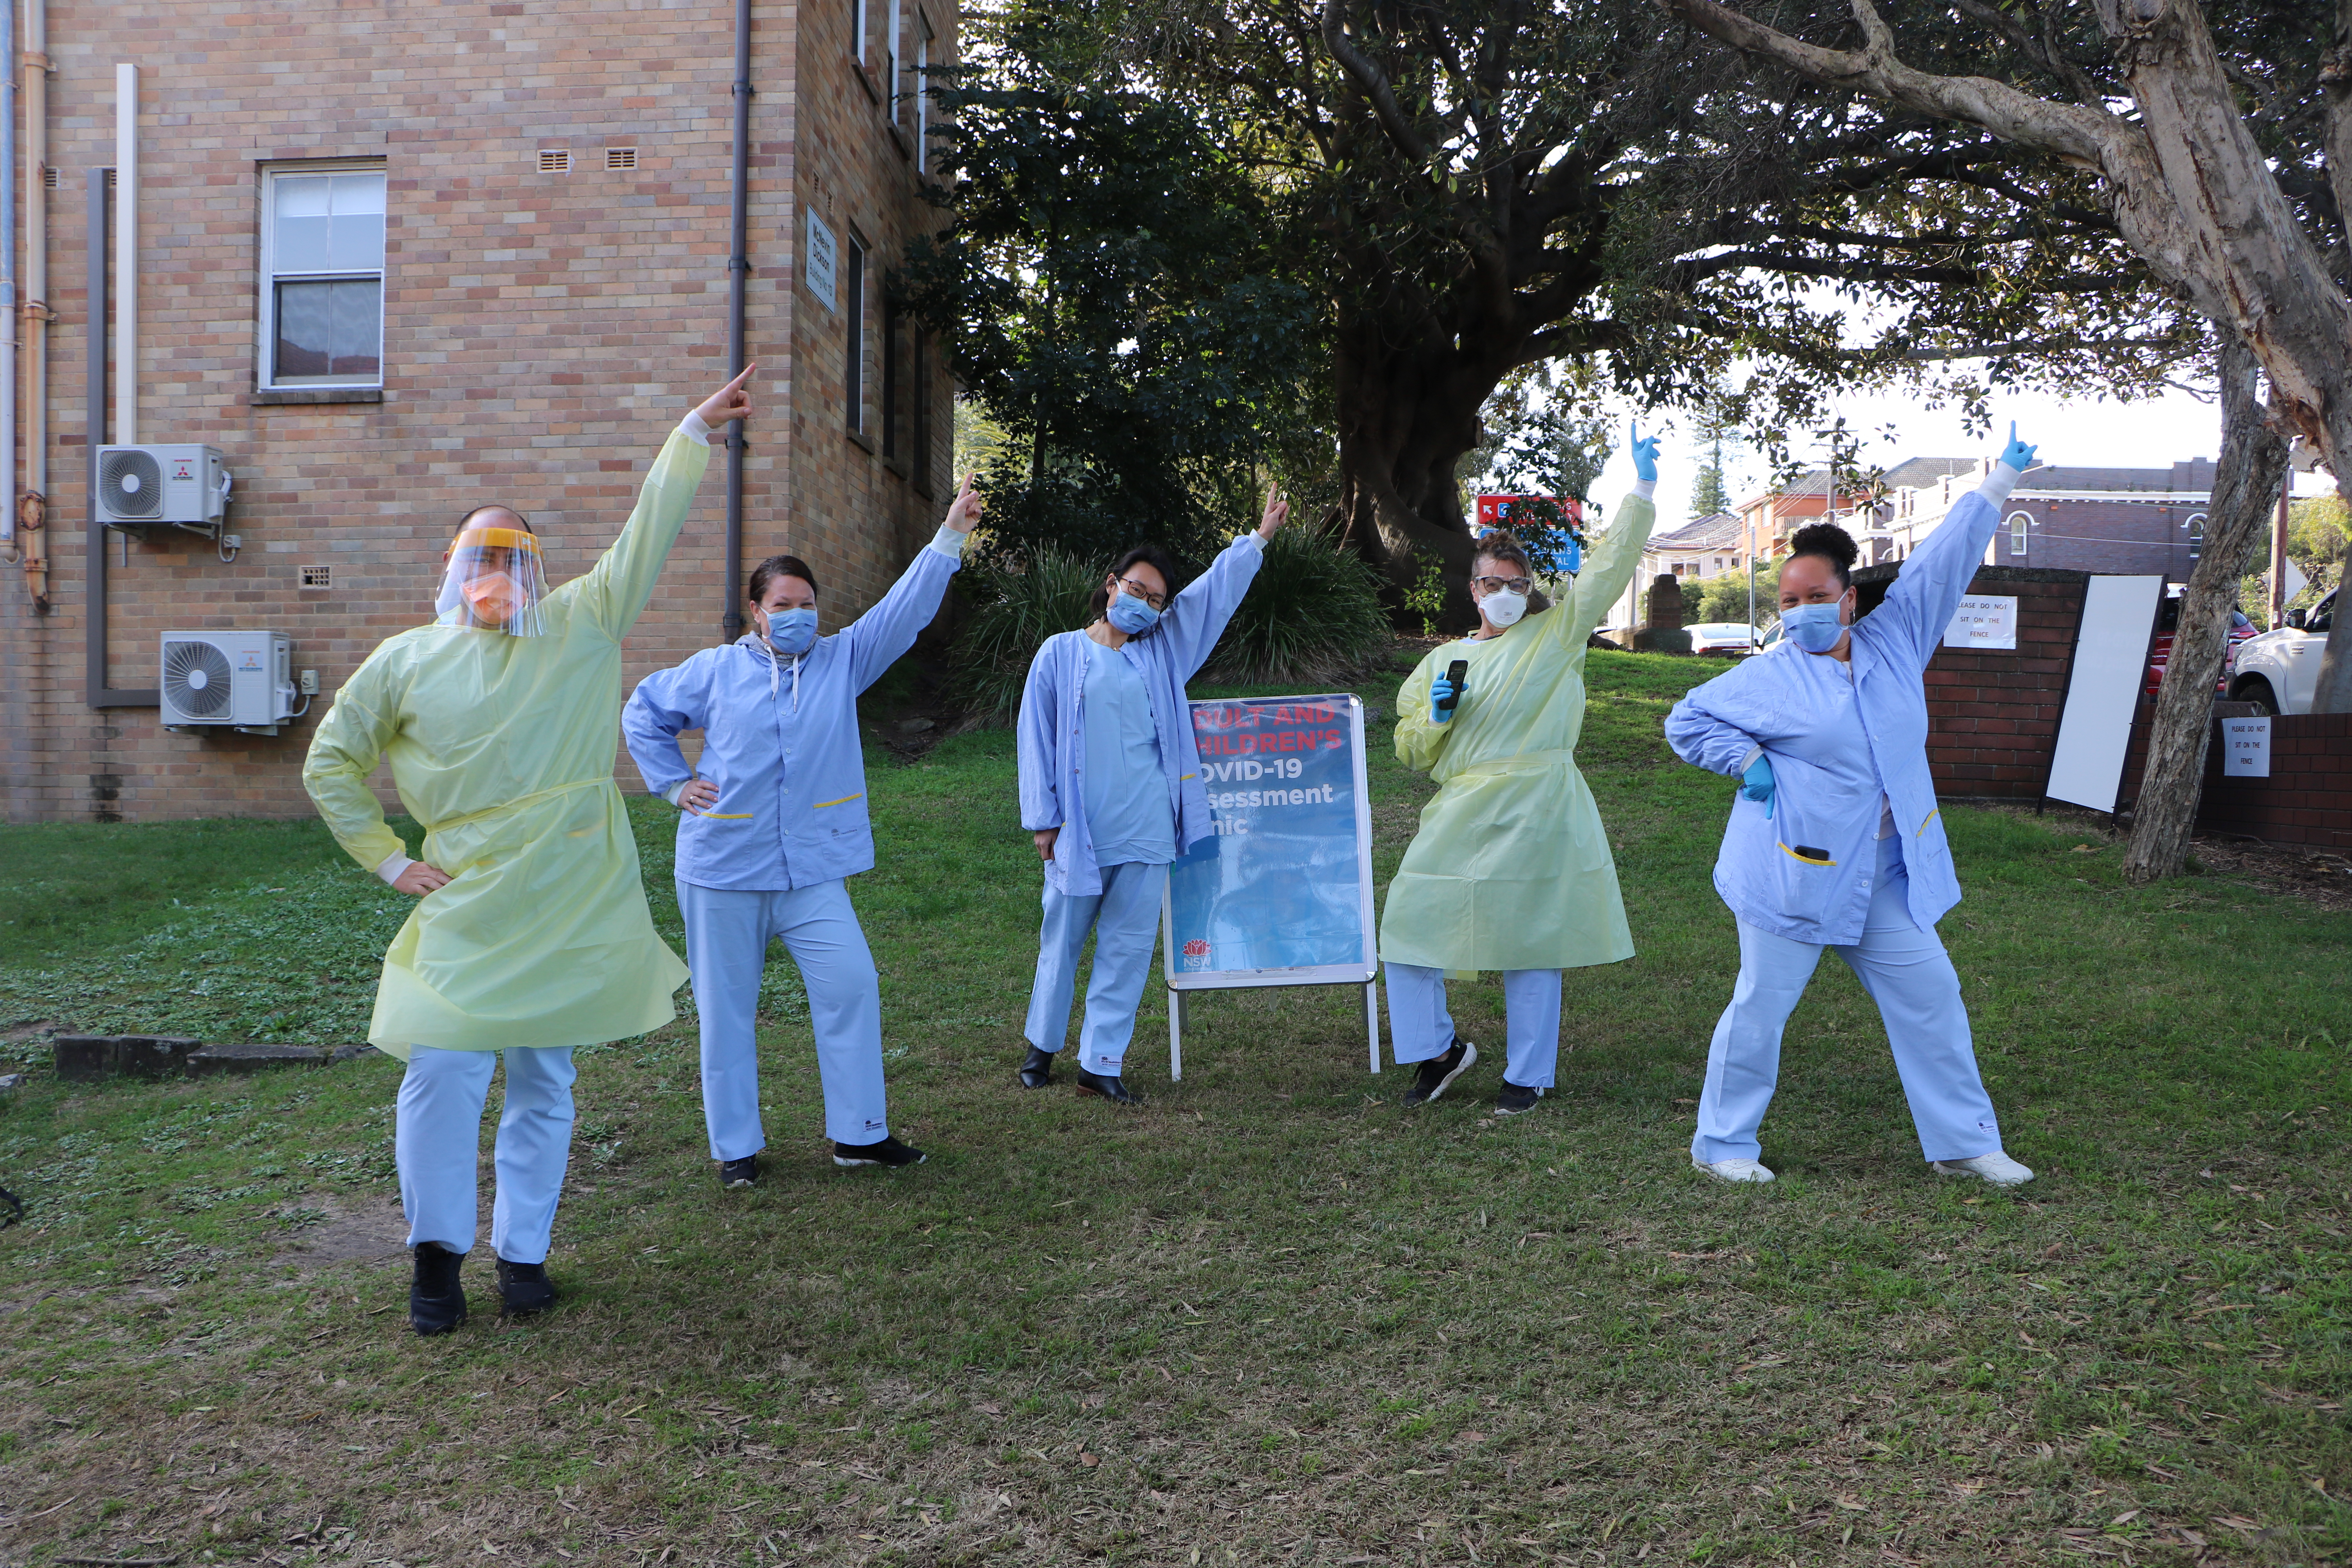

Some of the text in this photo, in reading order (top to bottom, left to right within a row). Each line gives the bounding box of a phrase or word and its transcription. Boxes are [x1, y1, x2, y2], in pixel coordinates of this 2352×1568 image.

[813, 222, 830, 255] McNevin
[813, 242, 829, 273] Dickson
[809, 262, 822, 289] Building
[828, 283, 832, 296] 13
[1194, 703, 1335, 730] DULT AND
[1196, 729, 1342, 756] HILDREN'S
[1200, 757, 1303, 783] OVID-19
[1208, 783, 1333, 809] sessment
[1211, 814, 1248, 836] nic
[1183, 956, 1211, 967] NSW
